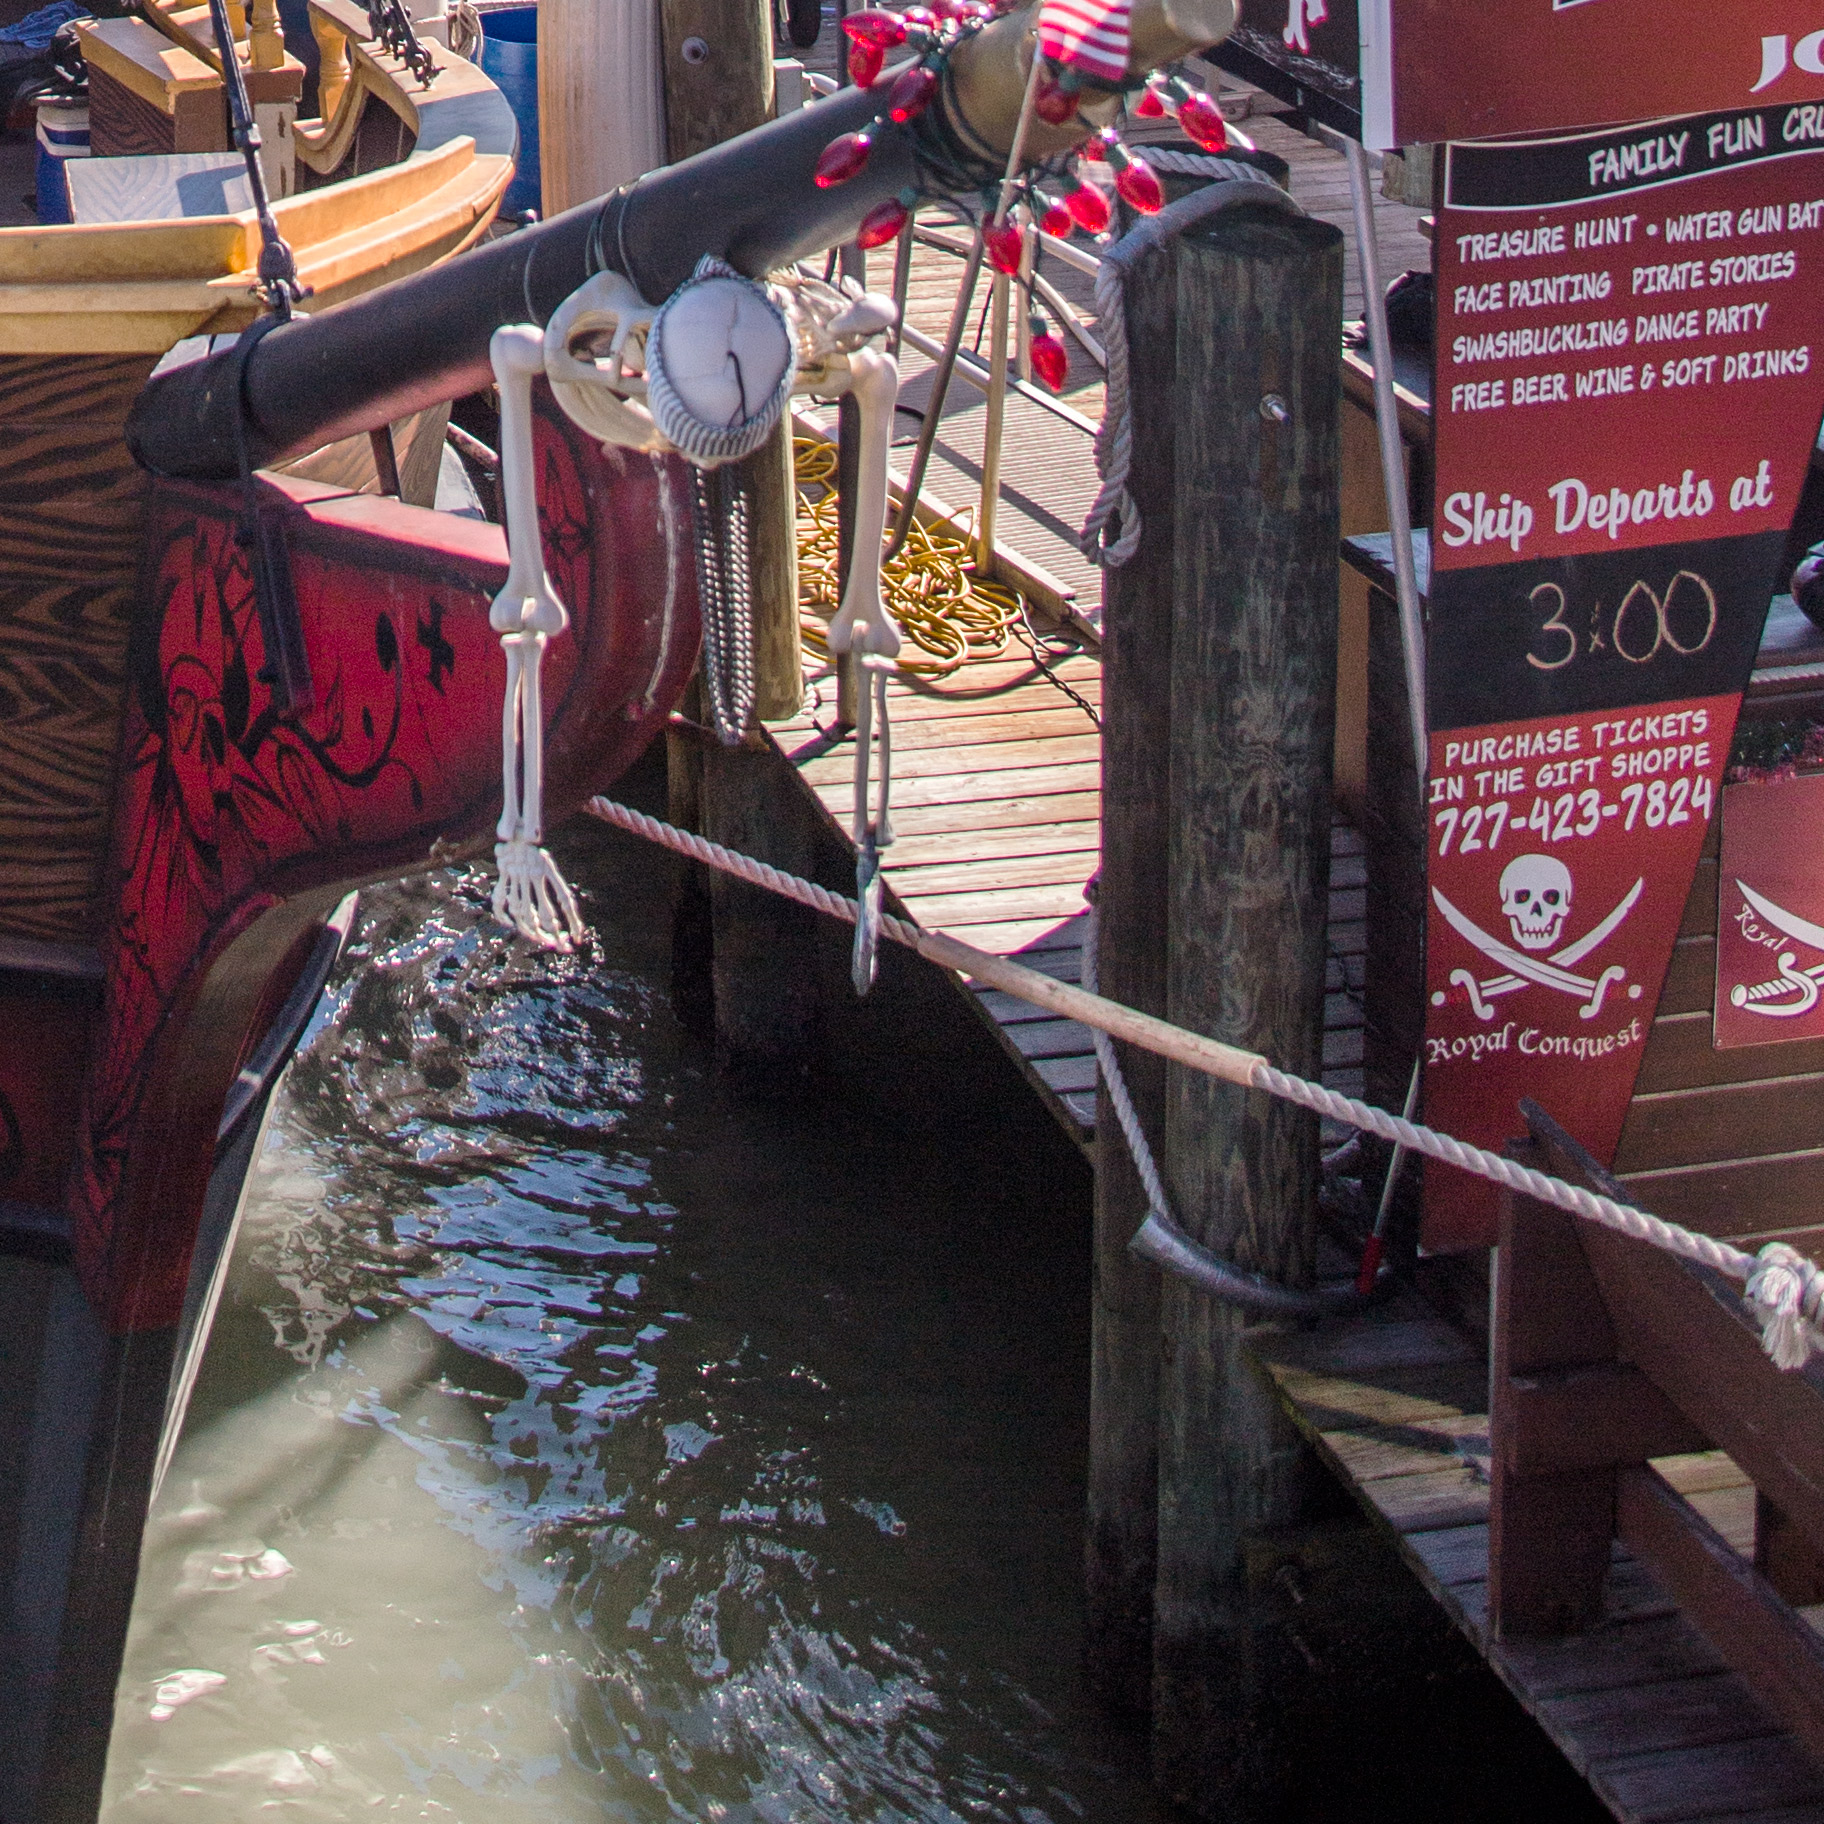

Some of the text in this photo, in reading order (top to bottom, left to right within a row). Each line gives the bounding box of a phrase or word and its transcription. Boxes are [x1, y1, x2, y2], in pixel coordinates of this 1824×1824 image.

[1588, 131, 1690, 186] FAMILY
[1707, 114, 1764, 158] FUN
[1456, 225, 1566, 263] TREASURE
[1574, 214, 1638, 249] HUNT
[1665, 209, 1732, 244] WATER
[1737, 205, 1781, 234] GUN
[1454, 250, 1796, 315] FACE PAINTING PIRATE STORIES
[1452, 302, 1769, 363] SWASHBUCKLING DANCE PARTY
[1451, 379, 1505, 412] FREE
[1575, 364, 1634, 399] WINE
[1641, 363, 1656, 390] &
[1662, 354, 1718, 389] SOFT
[1723, 345, 1809, 383] DRINKS
[1442, 459, 1775, 552] Ship Departs at
[1445, 708, 1708, 767] PURCHASE TICKETS
[1429, 740, 1711, 804] IN THE GIFT SHOPPE
[1435, 773, 1713, 856] 727-423-7824
[1734, 903, 1789, 951] Royal
[1427, 1017, 1641, 1064] Royal Conquest
